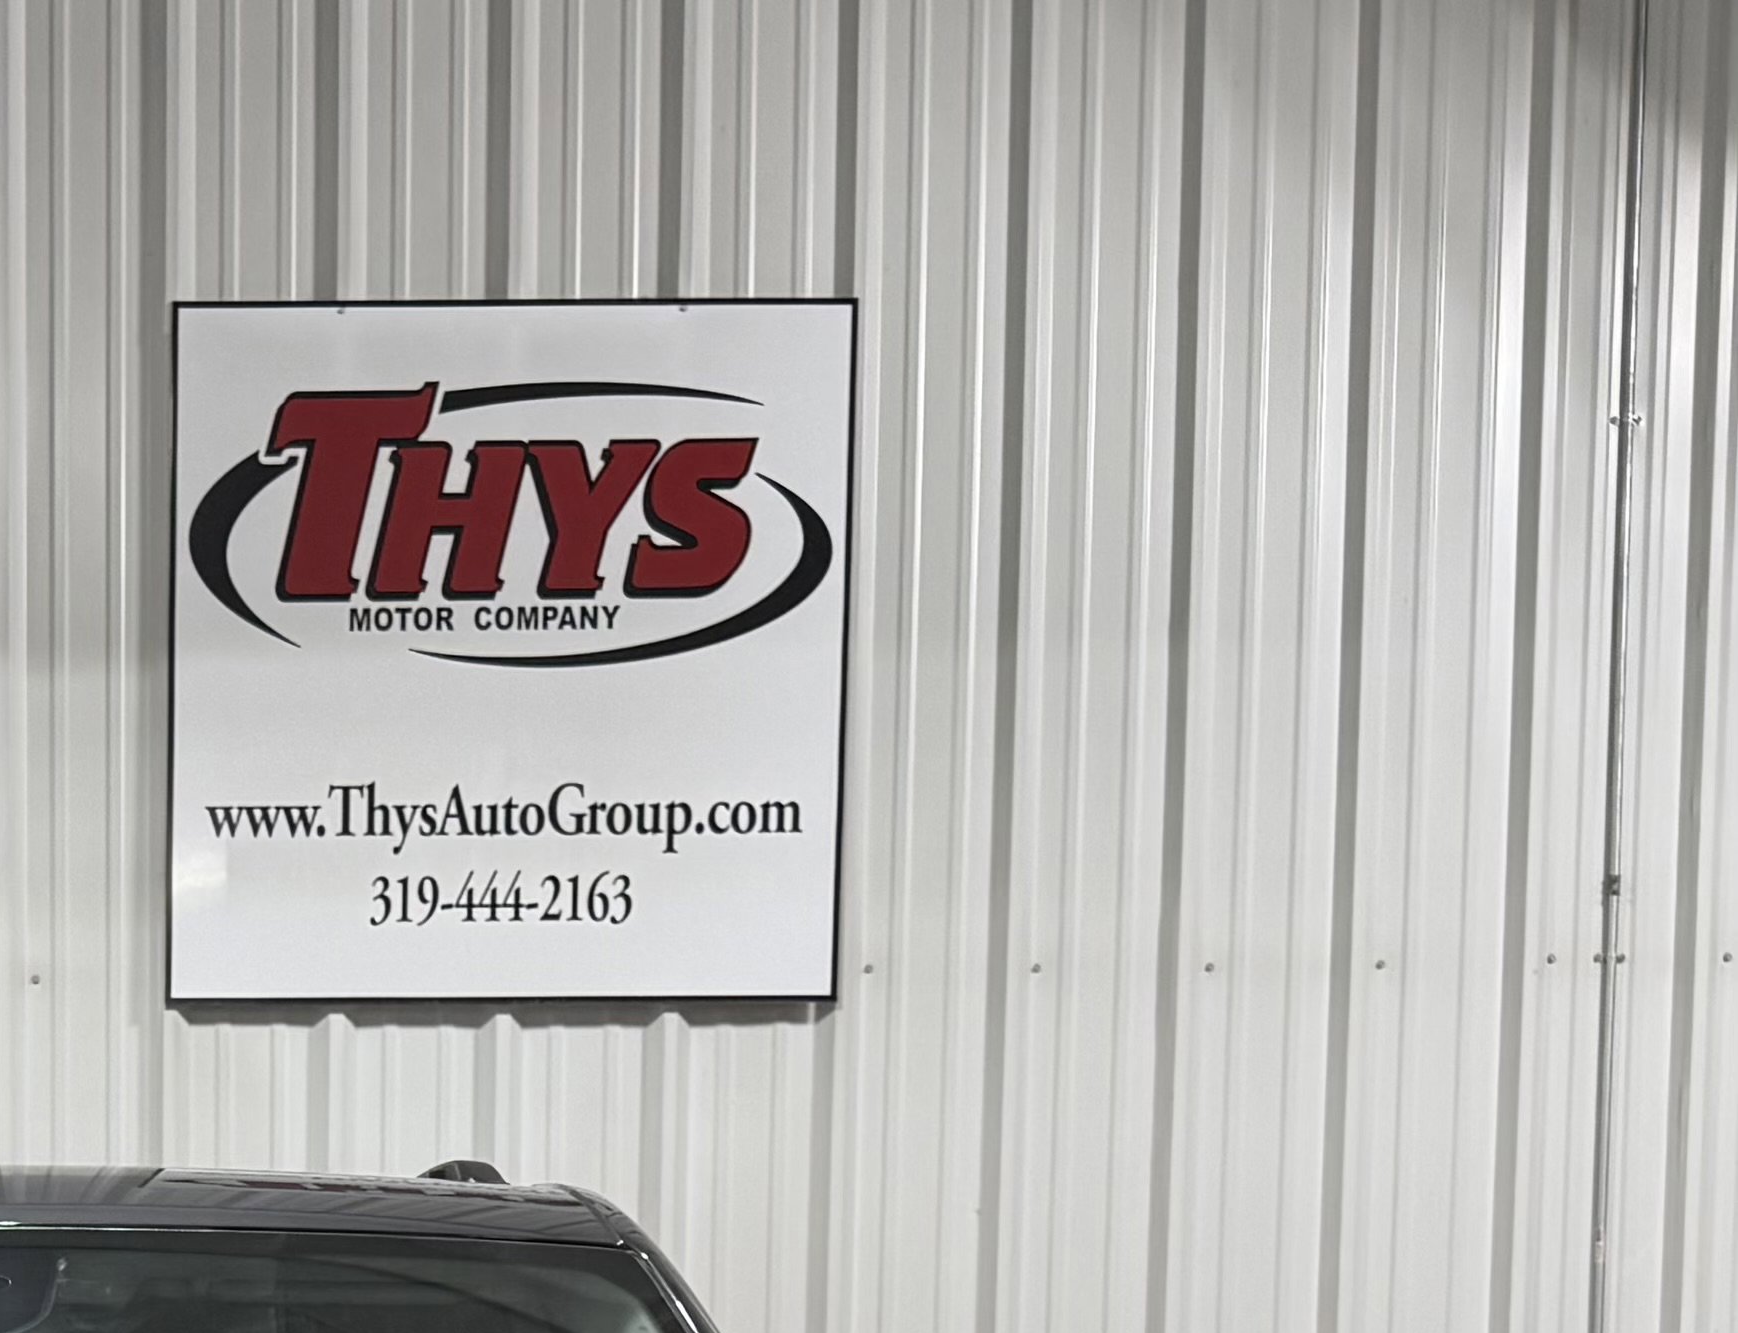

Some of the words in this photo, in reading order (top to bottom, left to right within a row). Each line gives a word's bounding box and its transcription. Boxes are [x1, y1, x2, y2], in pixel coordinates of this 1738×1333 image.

[265, 381, 759, 601] THYS
[349, 606, 454, 632] MOTOR
[474, 604, 621, 631] COMPANY
[205, 781, 803, 855] www.ThysAutoGroup.com
[369, 869, 633, 926] 319-444-2163
